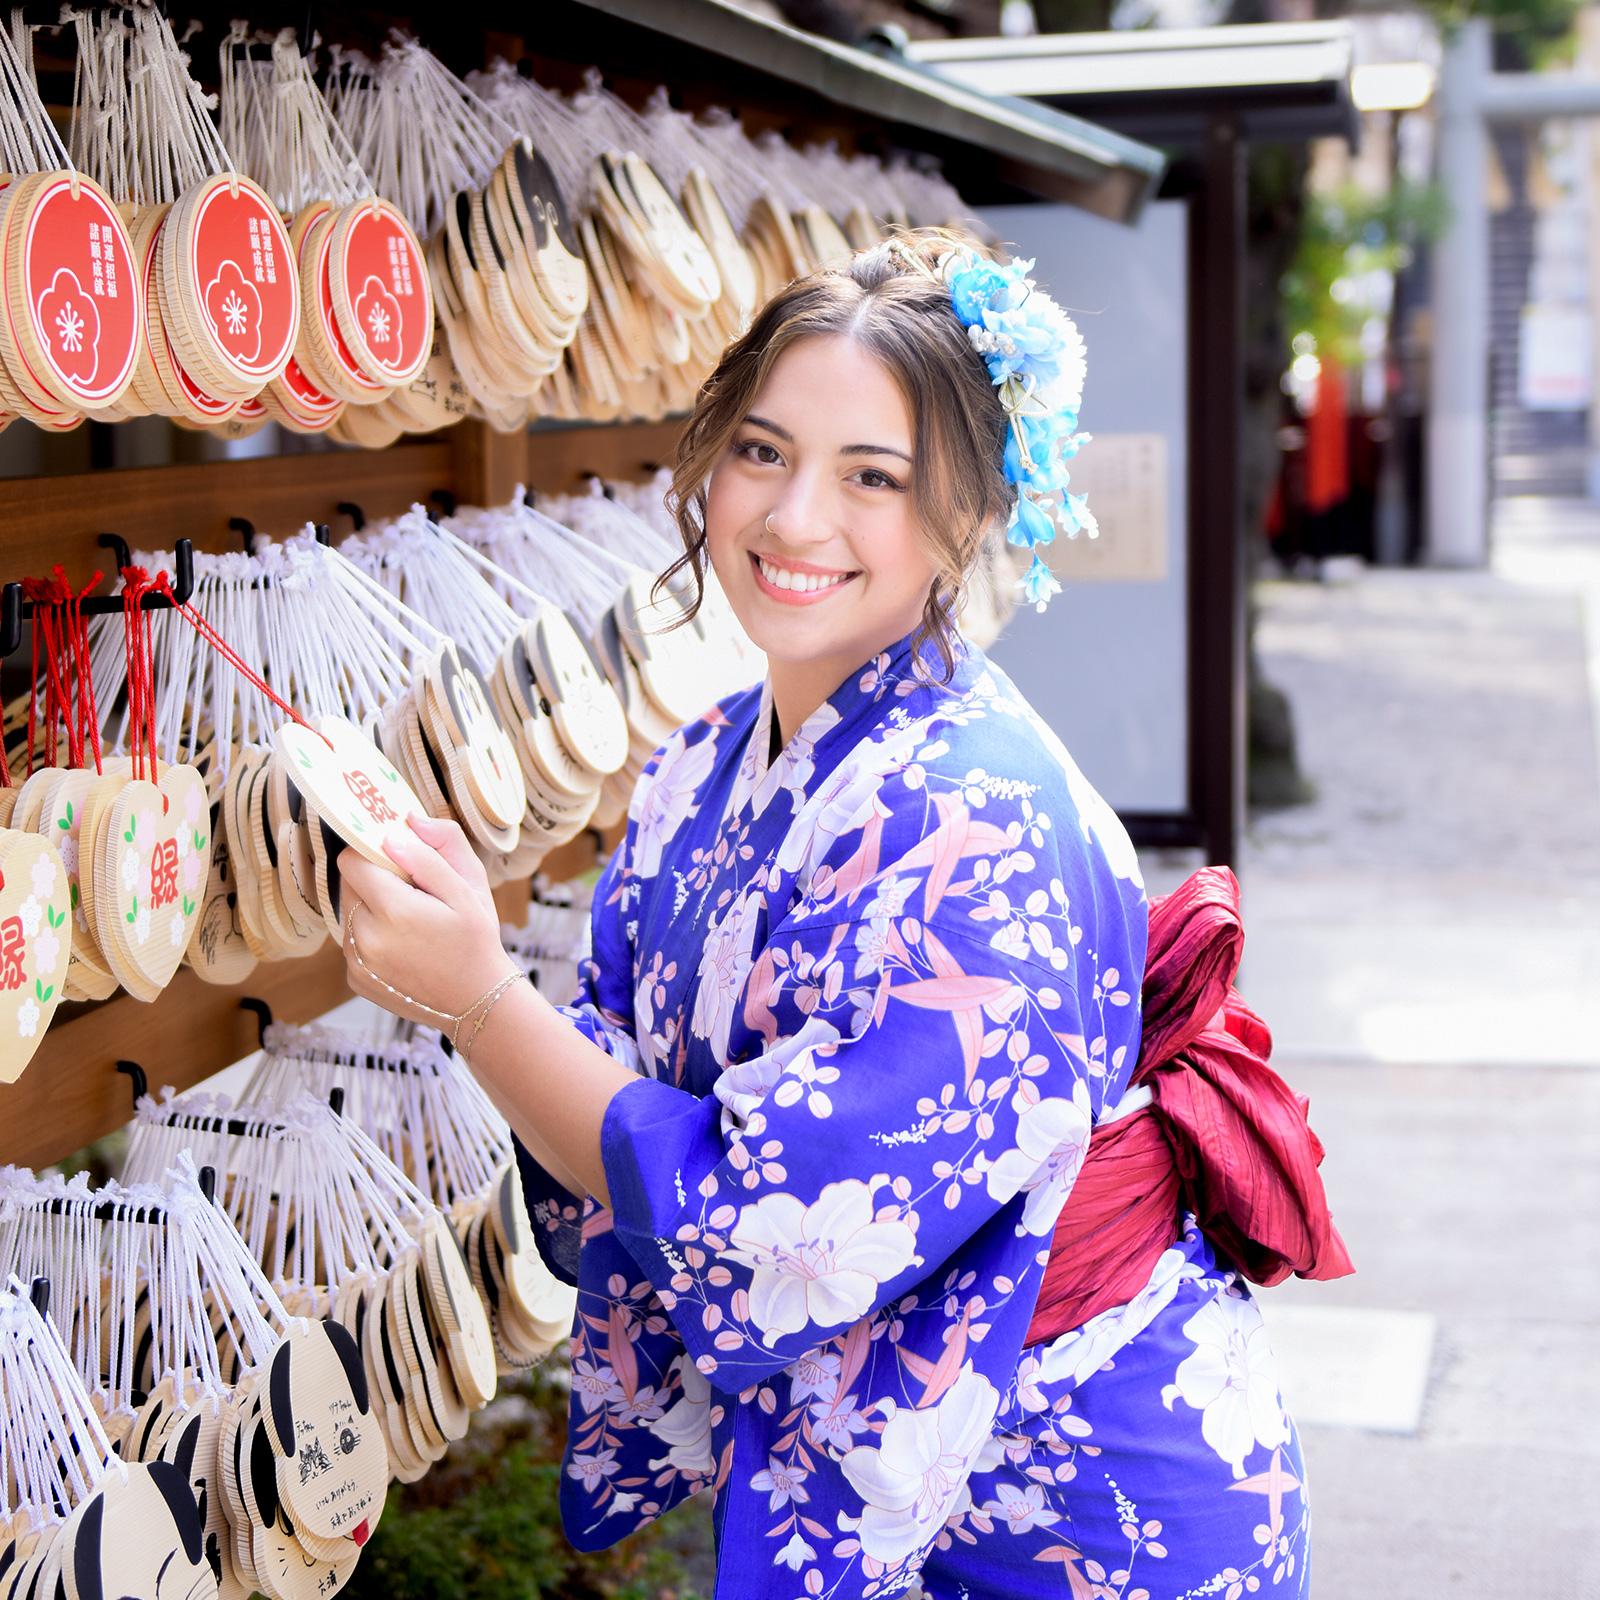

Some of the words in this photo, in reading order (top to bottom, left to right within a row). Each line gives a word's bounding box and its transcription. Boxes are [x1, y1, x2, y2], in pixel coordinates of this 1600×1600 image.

[89, 222, 105, 296] 諸願成就
[102, 225, 118, 298] 開運招福
[150, 837, 179, 910] 縁
